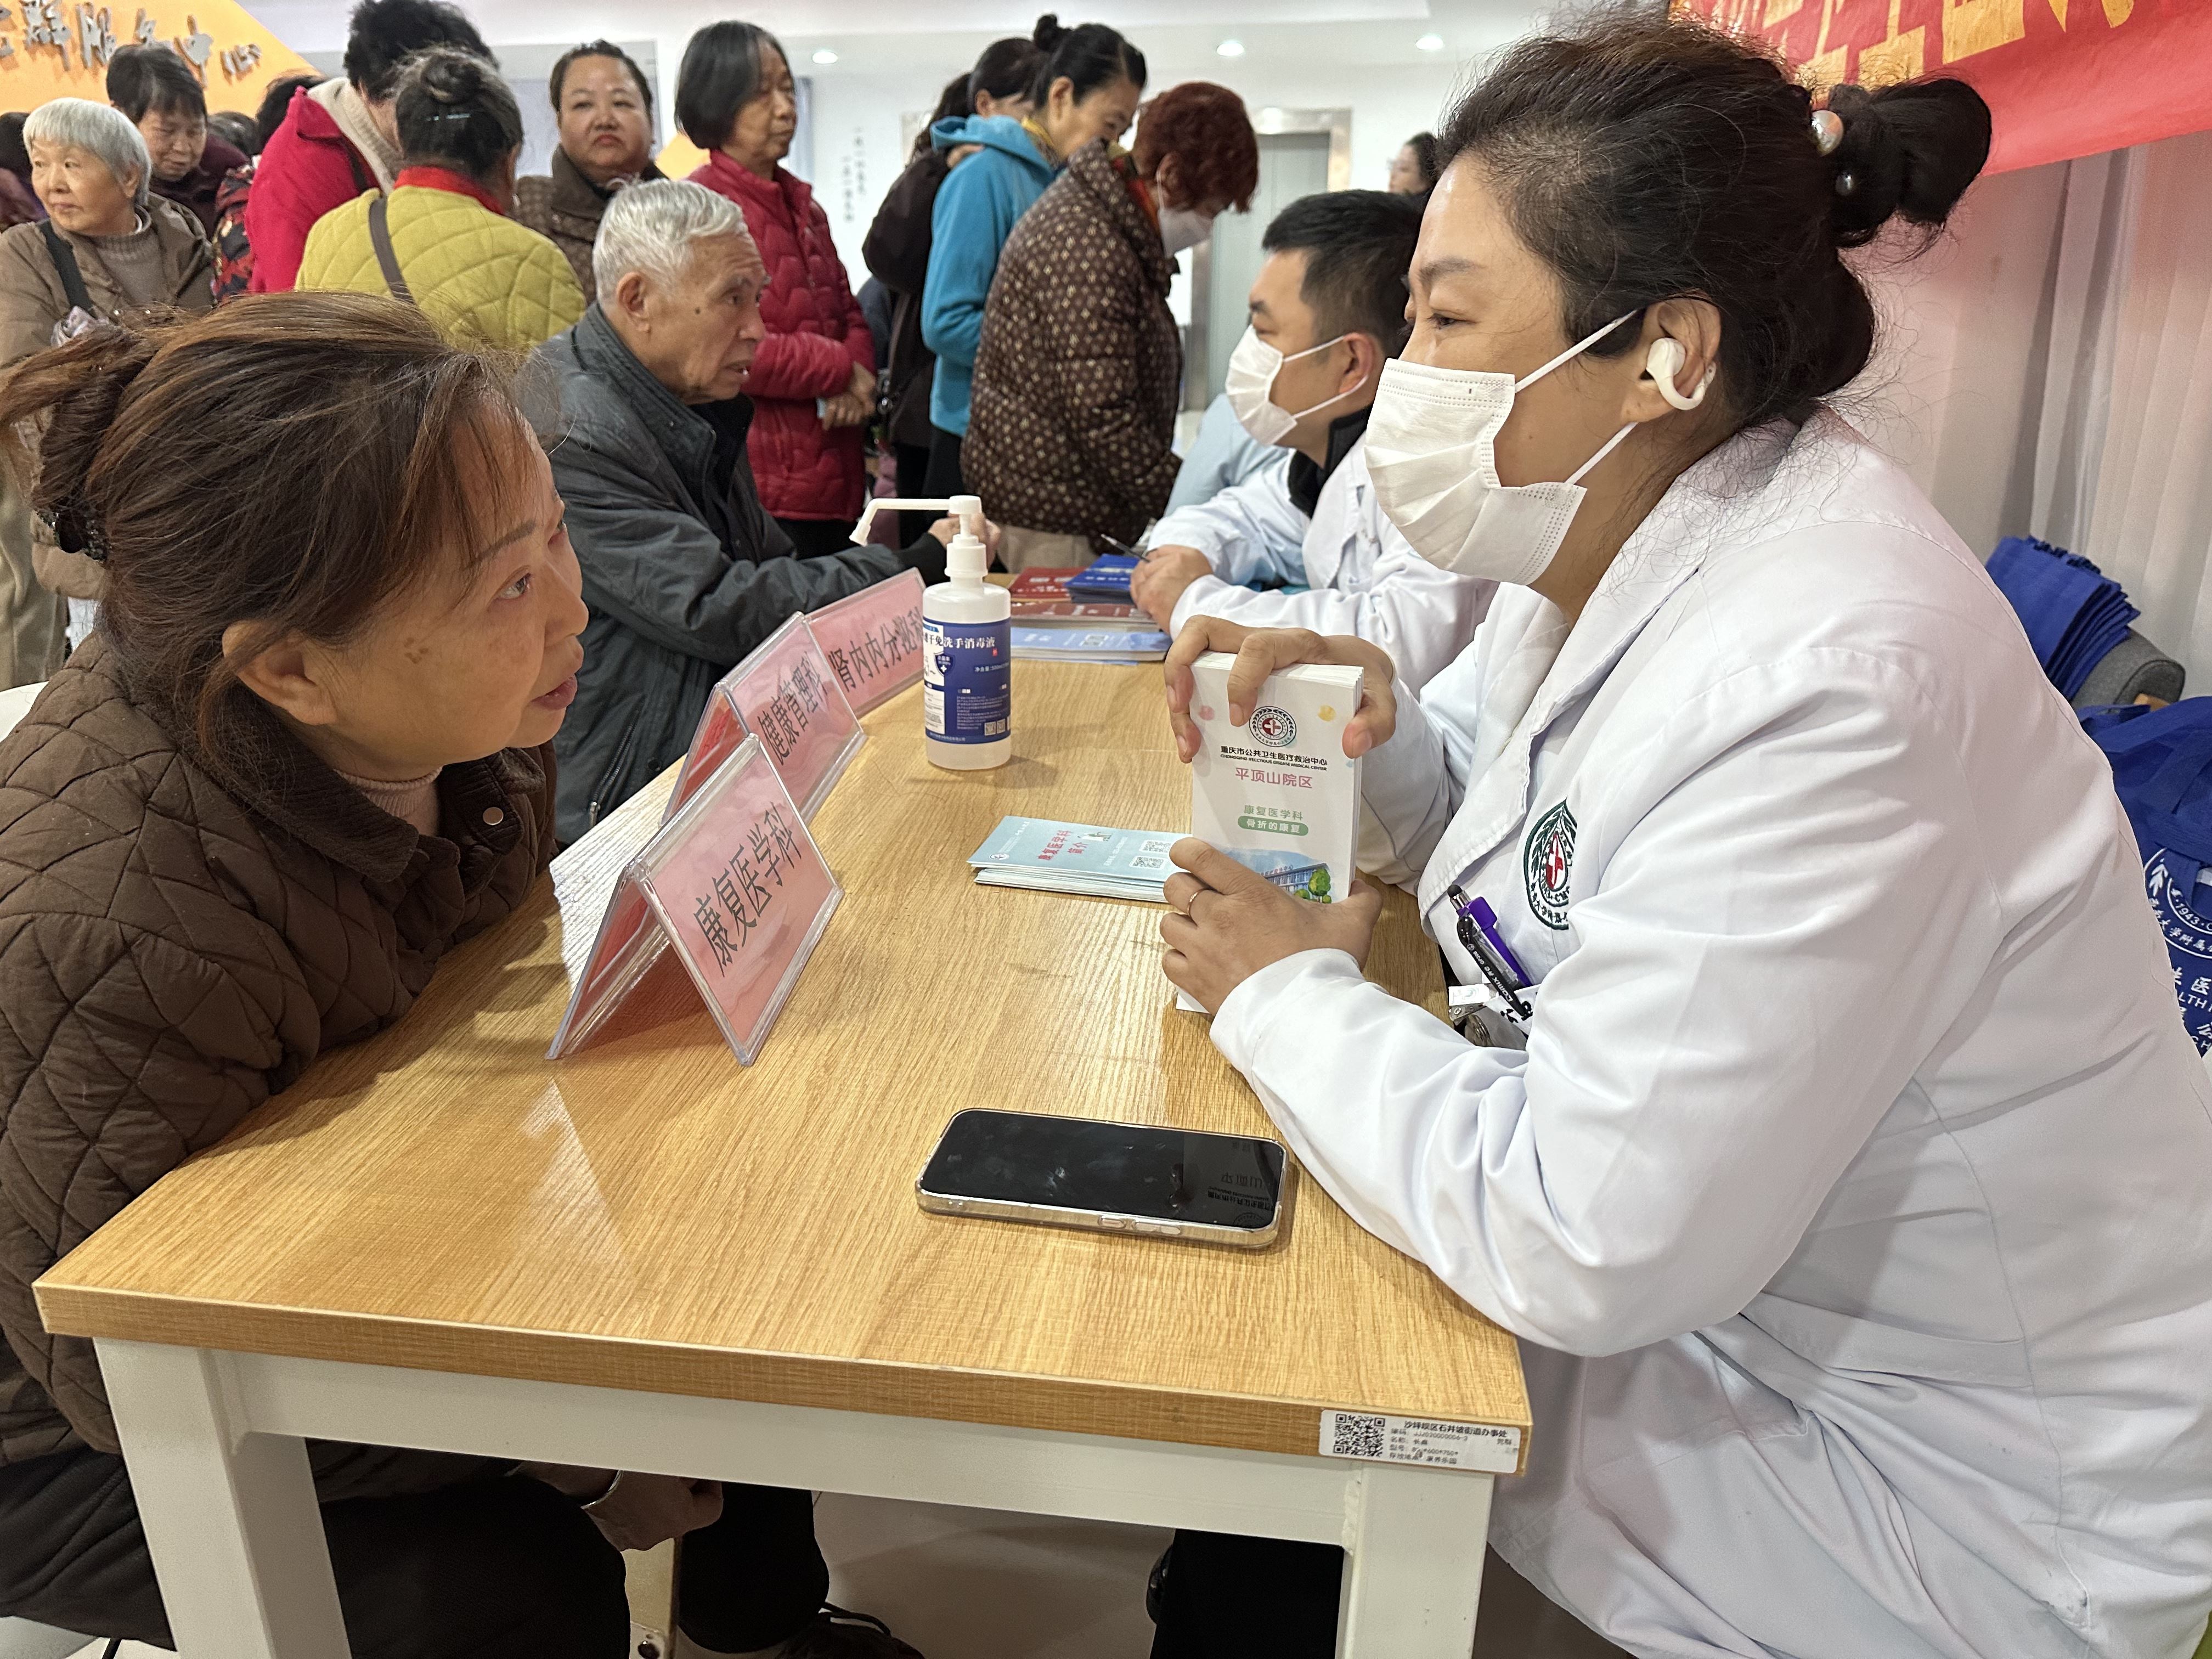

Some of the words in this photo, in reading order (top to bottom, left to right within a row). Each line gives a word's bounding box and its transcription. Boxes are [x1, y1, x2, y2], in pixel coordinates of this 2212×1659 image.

[827, 606, 923, 692] 肾内内分泌科
[757, 651, 829, 765] 健康管理科
[1221, 746, 1328, 766] 重庆市公共卫生医疗救治中心
[1235, 767, 1313, 789] 平顶山院区
[1243, 804, 1304, 821] 康复医学科
[1246, 818, 1300, 834] 骨折的康复
[693, 802, 802, 978] 康复医学科
[1404, 1420, 1508, 1437] 沙坪坝区石井坡街道办事处
